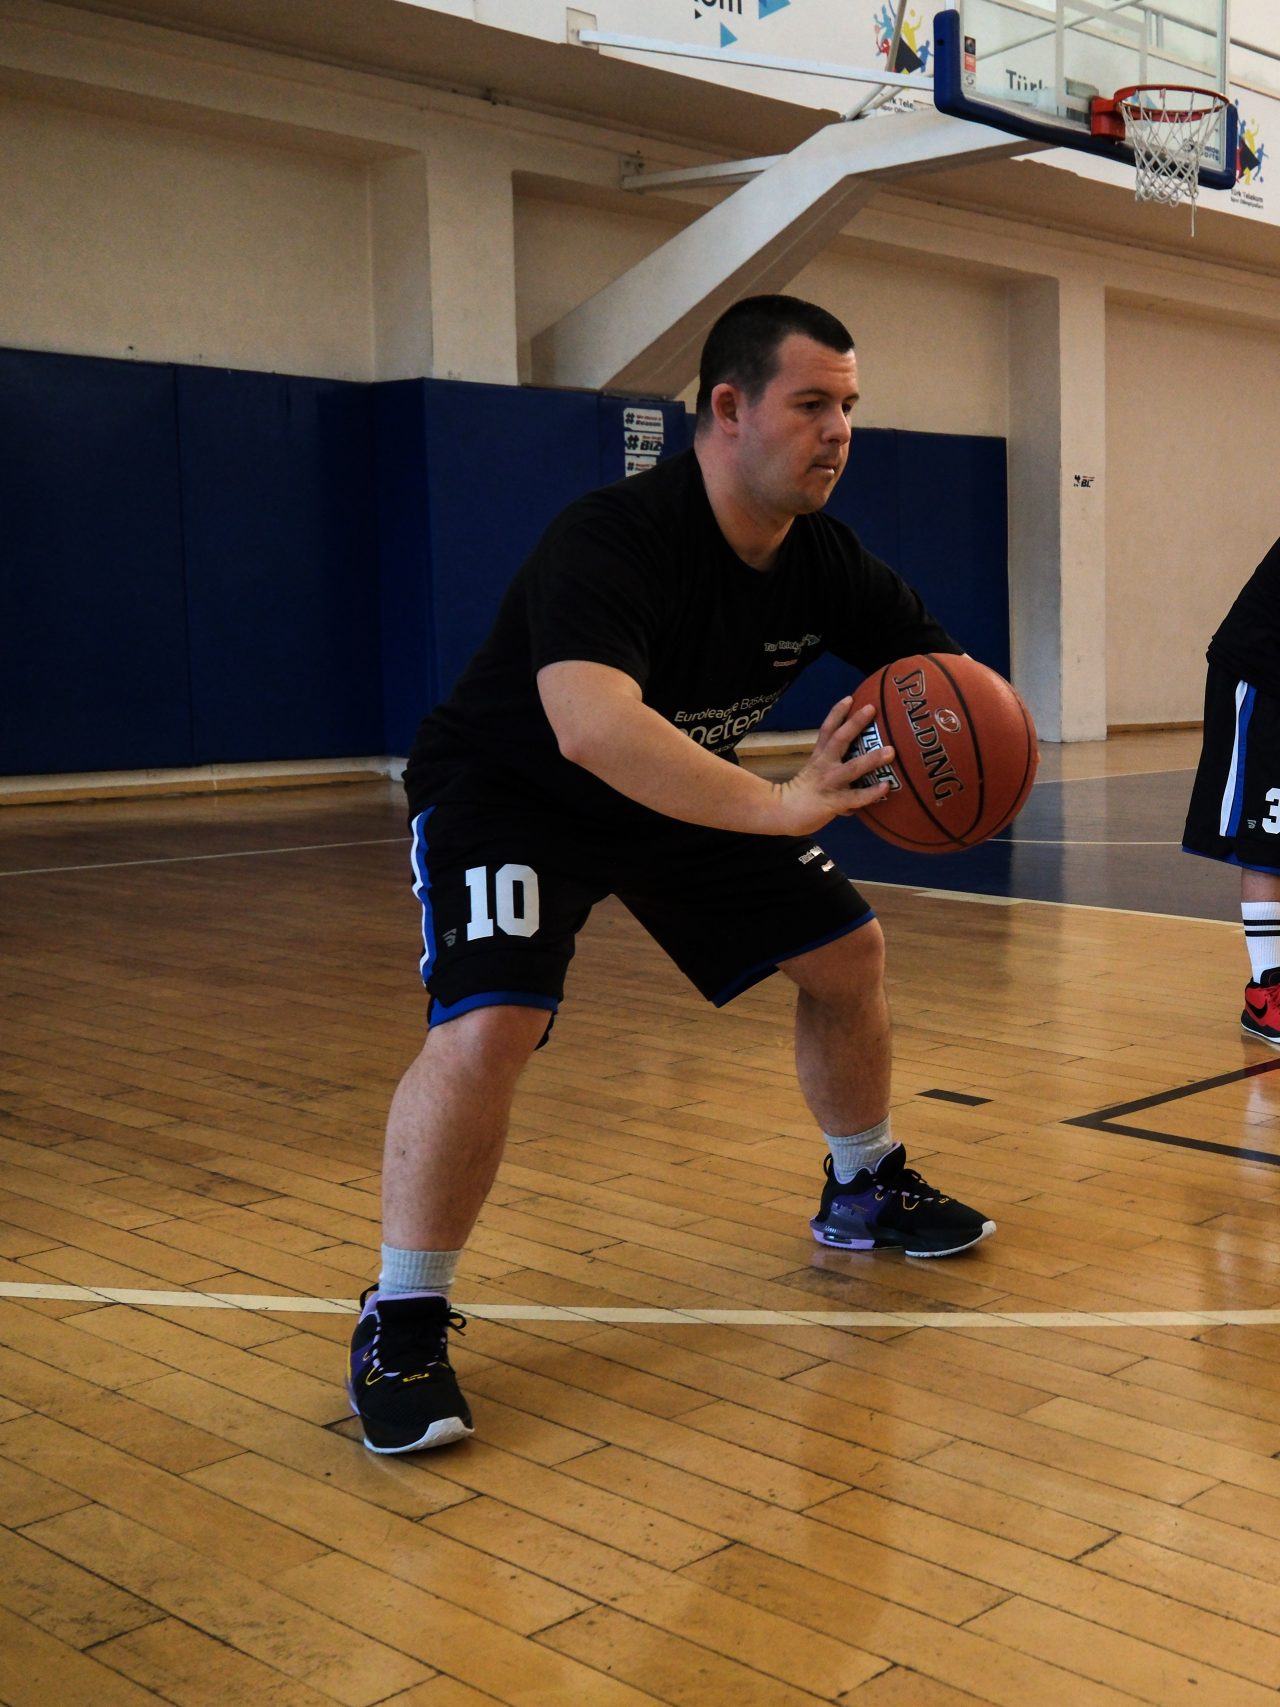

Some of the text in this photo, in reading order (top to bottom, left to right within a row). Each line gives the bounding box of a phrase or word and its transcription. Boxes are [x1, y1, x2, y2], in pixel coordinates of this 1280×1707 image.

[674, 702, 740, 722] Euroleage
[892, 668, 965, 802] SPALDING
[465, 863, 540, 941] 10
